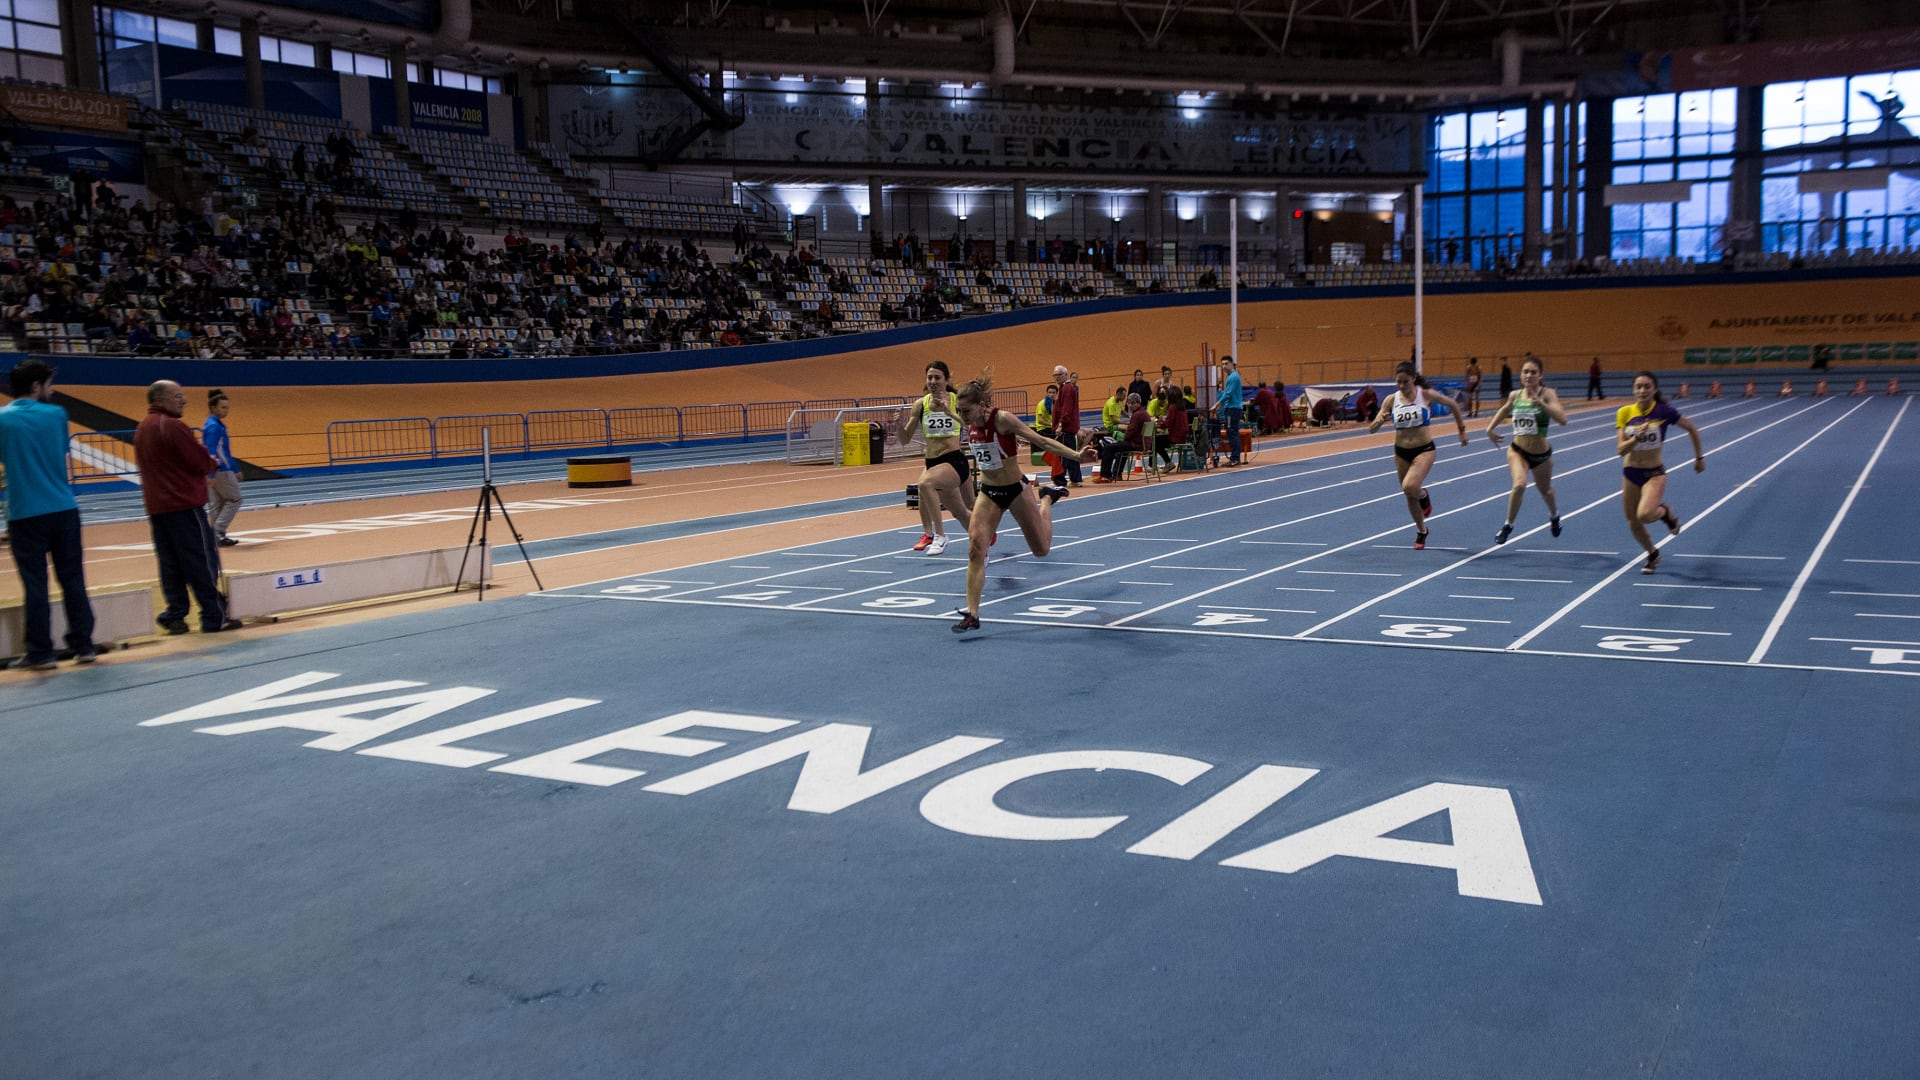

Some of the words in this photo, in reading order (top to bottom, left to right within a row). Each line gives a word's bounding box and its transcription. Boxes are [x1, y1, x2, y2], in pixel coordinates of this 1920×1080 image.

[7, 90, 85, 112] VALENCIA
[87, 99, 120, 116] 2011
[412, 101, 460, 120] VALENCIA
[461, 107, 482, 122] 2008
[901, 110, 1000, 122] VALENCIA
[1008, 115, 1089, 126] VALENCIA
[1093, 117, 1167, 129] VALENCIA
[963, 122, 1055, 136] VALENCIA
[868, 132, 1171, 161] VALENCIA
[1709, 315, 1837, 328] AJUNTAMENT
[1840, 313, 1869, 325] DE
[928, 418, 953, 429] 235
[1396, 411, 1419, 423] 201
[1013, 604, 1097, 618] 5
[1192, 612, 1269, 626] 4
[1380, 623, 1468, 639] 3
[1597, 635, 1694, 652] 2
[138, 671, 1543, 906] VALENCIA
